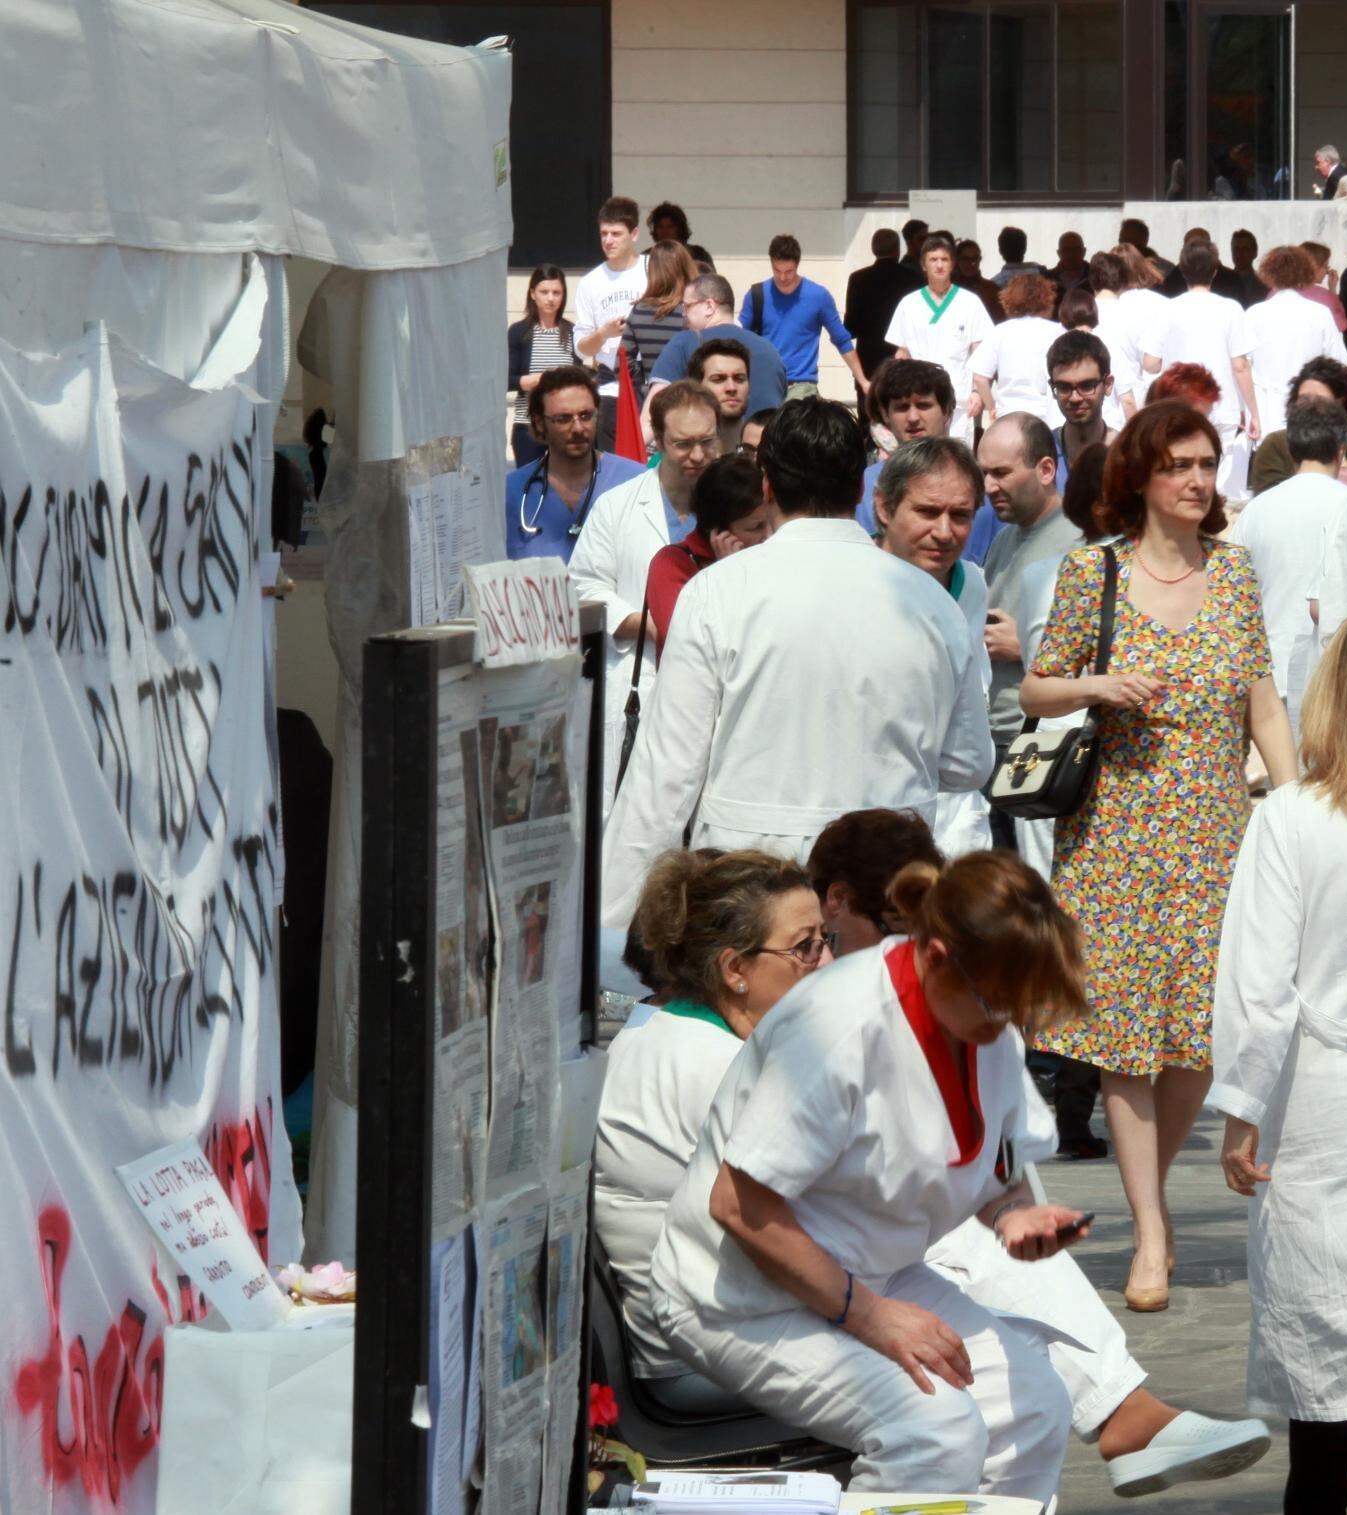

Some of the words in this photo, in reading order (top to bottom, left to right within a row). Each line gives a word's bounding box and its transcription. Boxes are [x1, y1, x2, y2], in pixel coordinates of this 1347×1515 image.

[601, 290, 640, 310] TIMBERLA
[131, 1181, 154, 1207] LA
[148, 1166, 190, 1198] LOTTA
